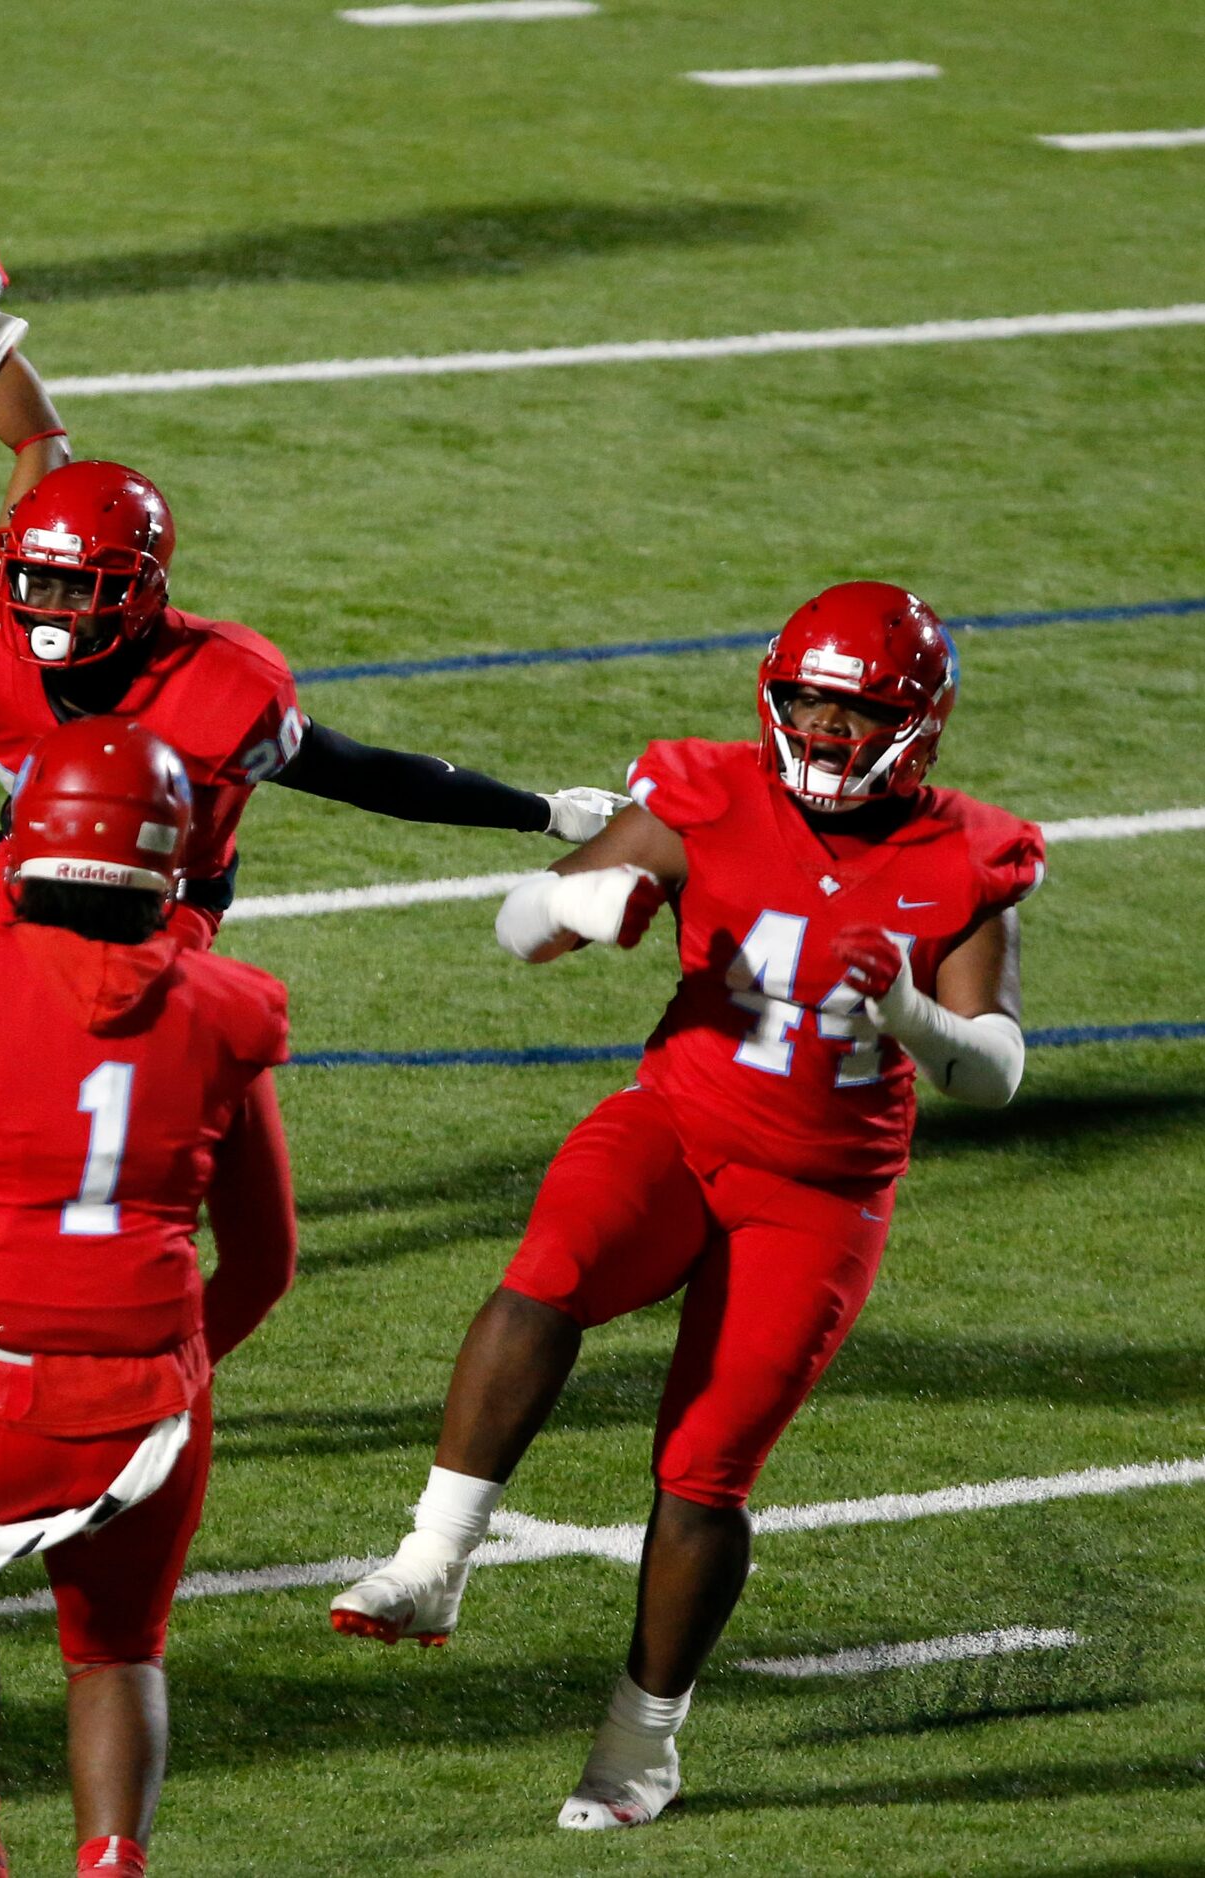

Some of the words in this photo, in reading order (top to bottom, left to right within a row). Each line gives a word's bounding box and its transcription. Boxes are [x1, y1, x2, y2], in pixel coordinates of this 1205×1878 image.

[56, 863, 132, 885] Riddell
[726, 908, 917, 1089] 44
[59, 1061, 136, 1236] 1
